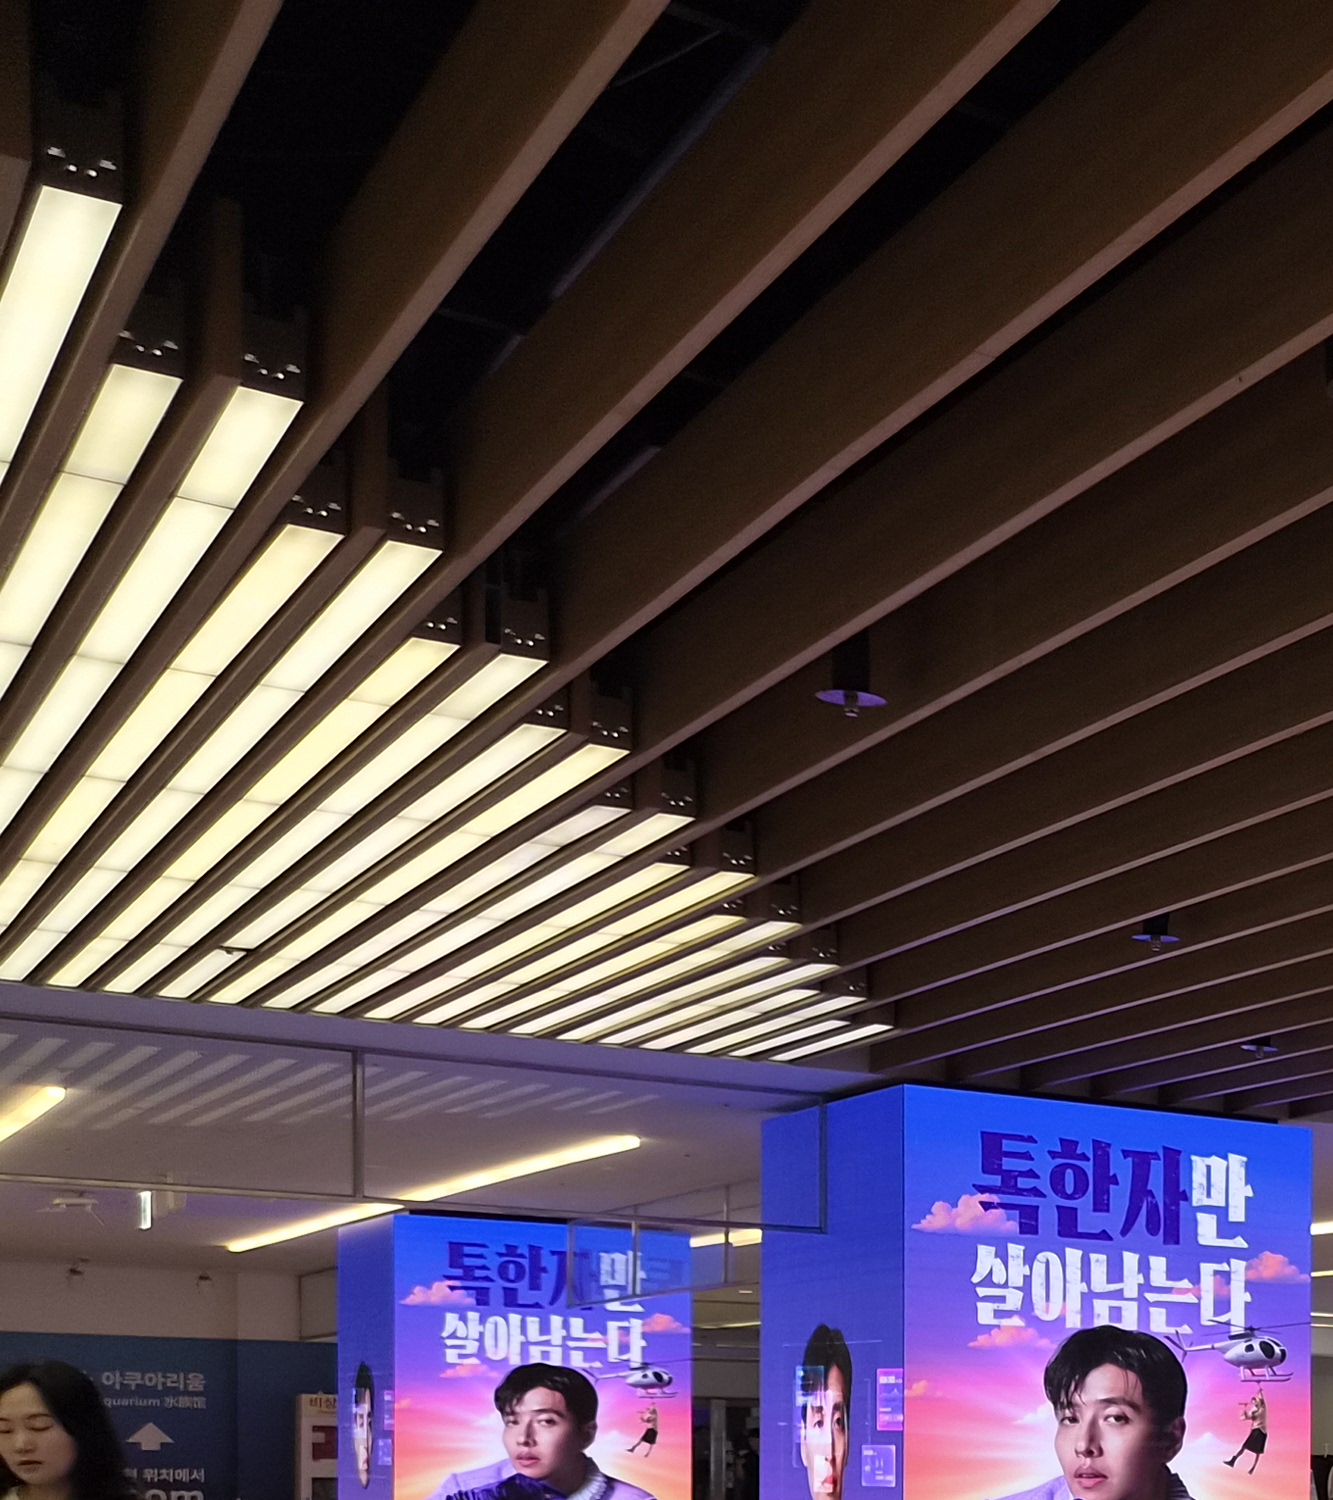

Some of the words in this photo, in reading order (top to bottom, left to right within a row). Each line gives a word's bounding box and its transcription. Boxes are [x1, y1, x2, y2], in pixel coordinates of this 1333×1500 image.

[972, 1131, 1254, 1248] 톡한자만
[442, 1241, 647, 1312] 톡한자만
[970, 1243, 1252, 1336] 살아남는다
[441, 1311, 647, 1368] 살아남는다
[102, 1371, 206, 1391] 아쿠아리움
[103, 1398, 161, 1409] quarium
[143, 1468, 205, 1484] 위치에서
